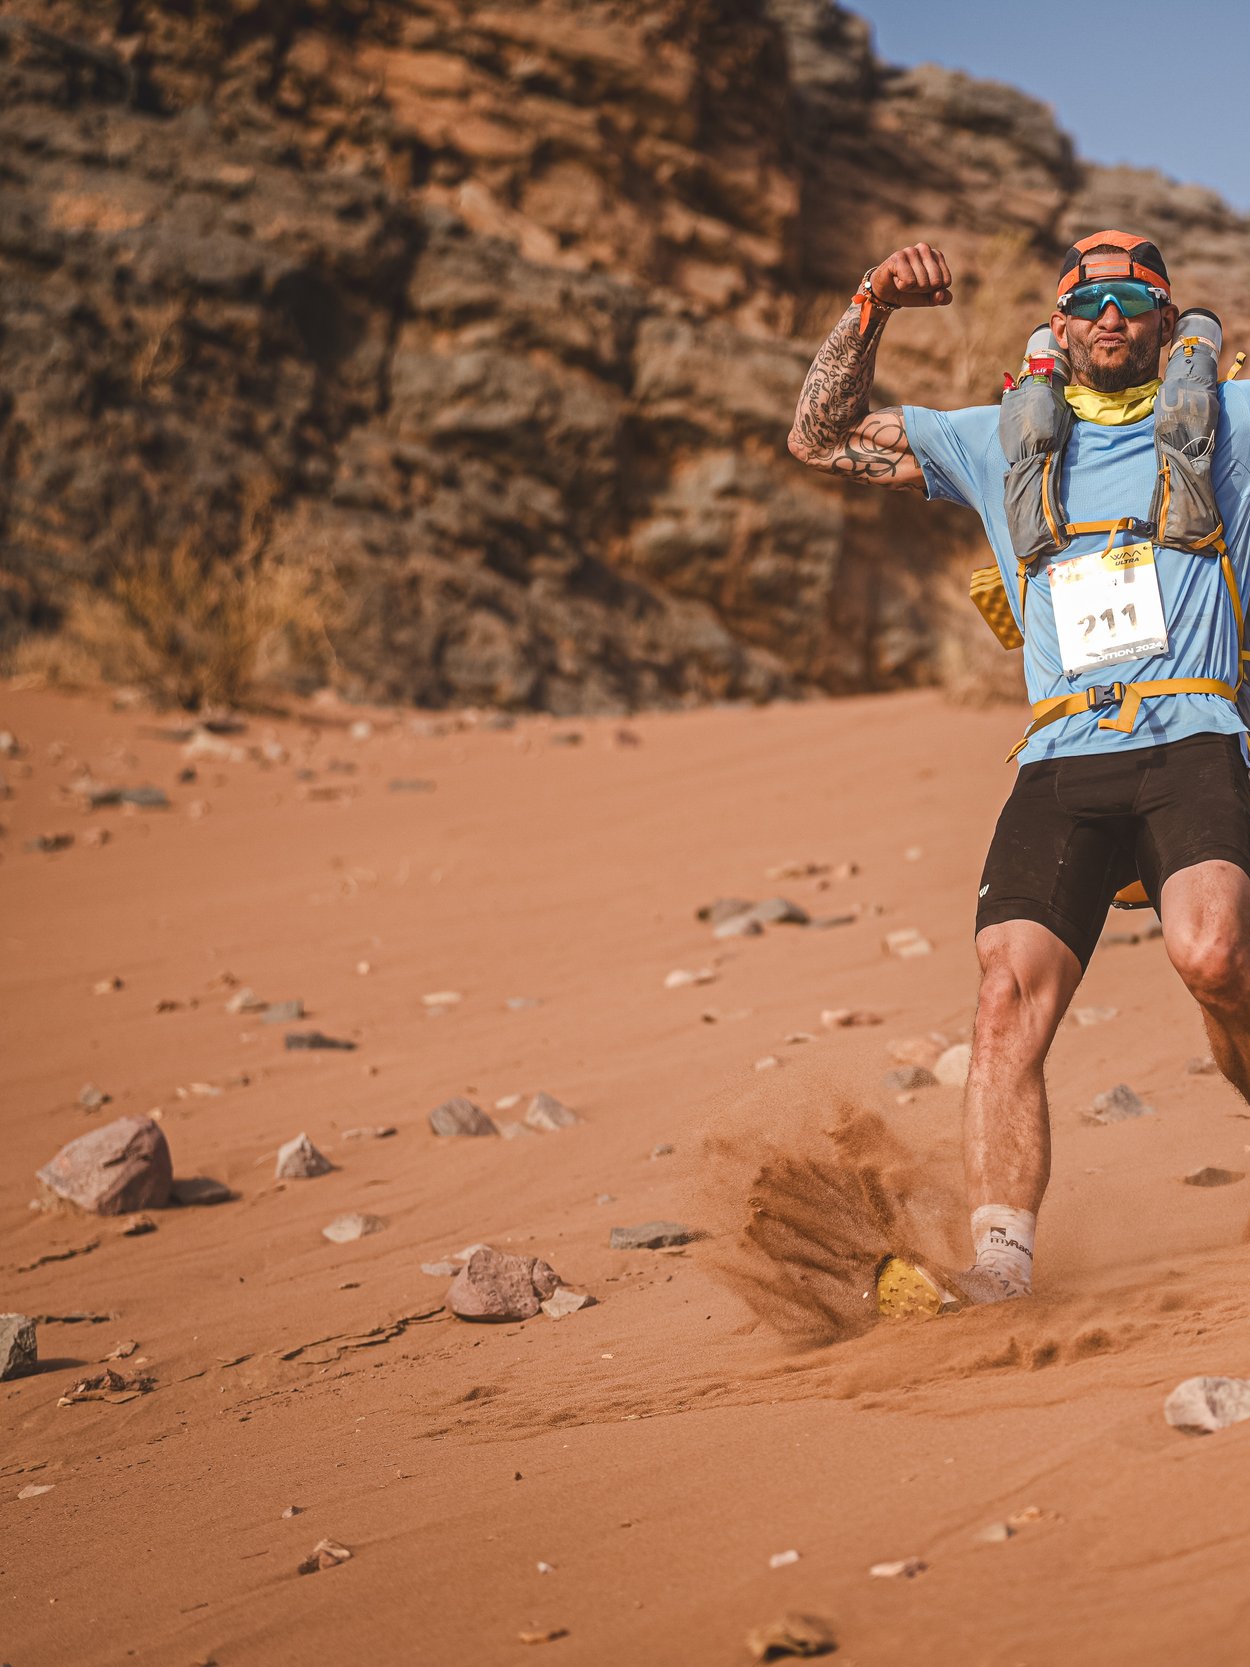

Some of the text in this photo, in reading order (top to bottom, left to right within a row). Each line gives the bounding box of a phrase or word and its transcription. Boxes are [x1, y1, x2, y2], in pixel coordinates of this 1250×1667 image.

[1115, 557, 1140, 566] ULTRA
[1077, 603, 1138, 639] 211
[1097, 641, 1163, 662] DITION 2024
